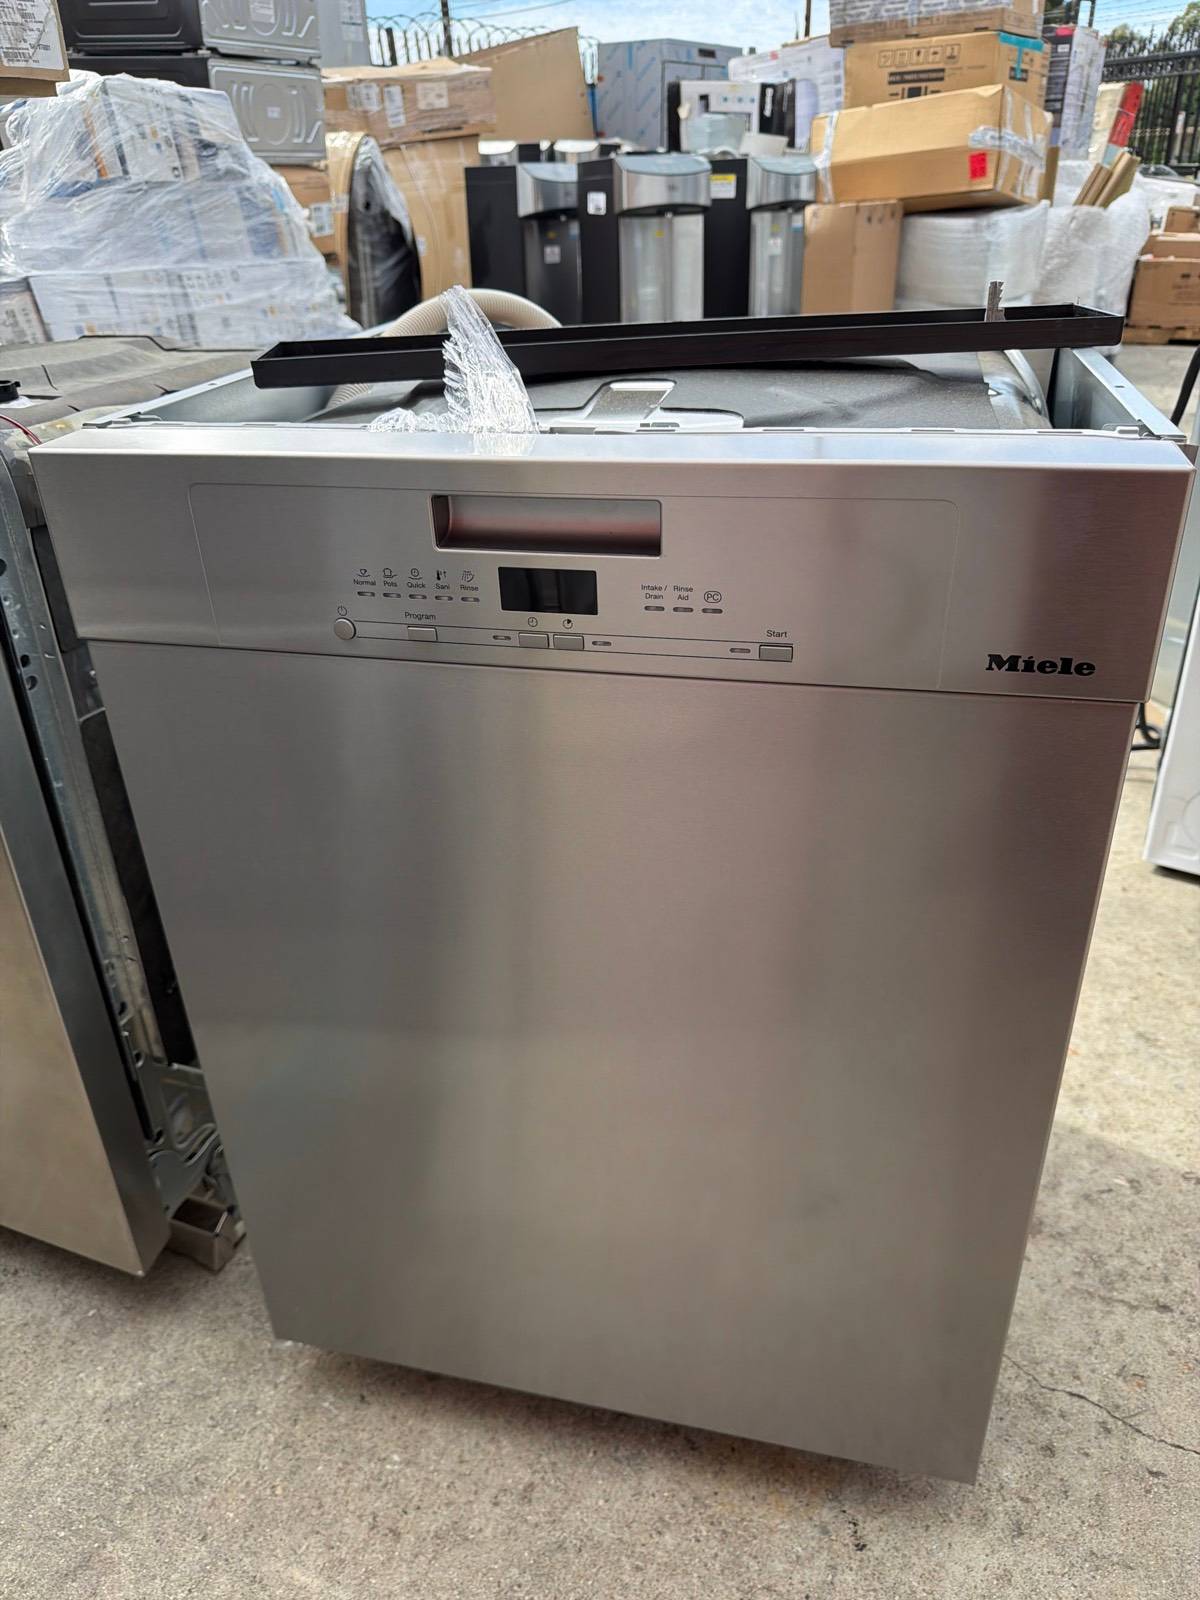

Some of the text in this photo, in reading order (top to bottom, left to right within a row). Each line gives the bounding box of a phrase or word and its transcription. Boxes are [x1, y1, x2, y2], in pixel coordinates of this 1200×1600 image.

[353, 579, 376, 587] Normal
[383, 580, 398, 588] Pots
[460, 584, 479, 592] Rinse
[673, 585, 694, 593] Rinse
[677, 593, 689, 601] Aid
[404, 612, 436, 621] Program
[766, 629, 788, 638] Start
[985, 653, 1096, 676] Miele
